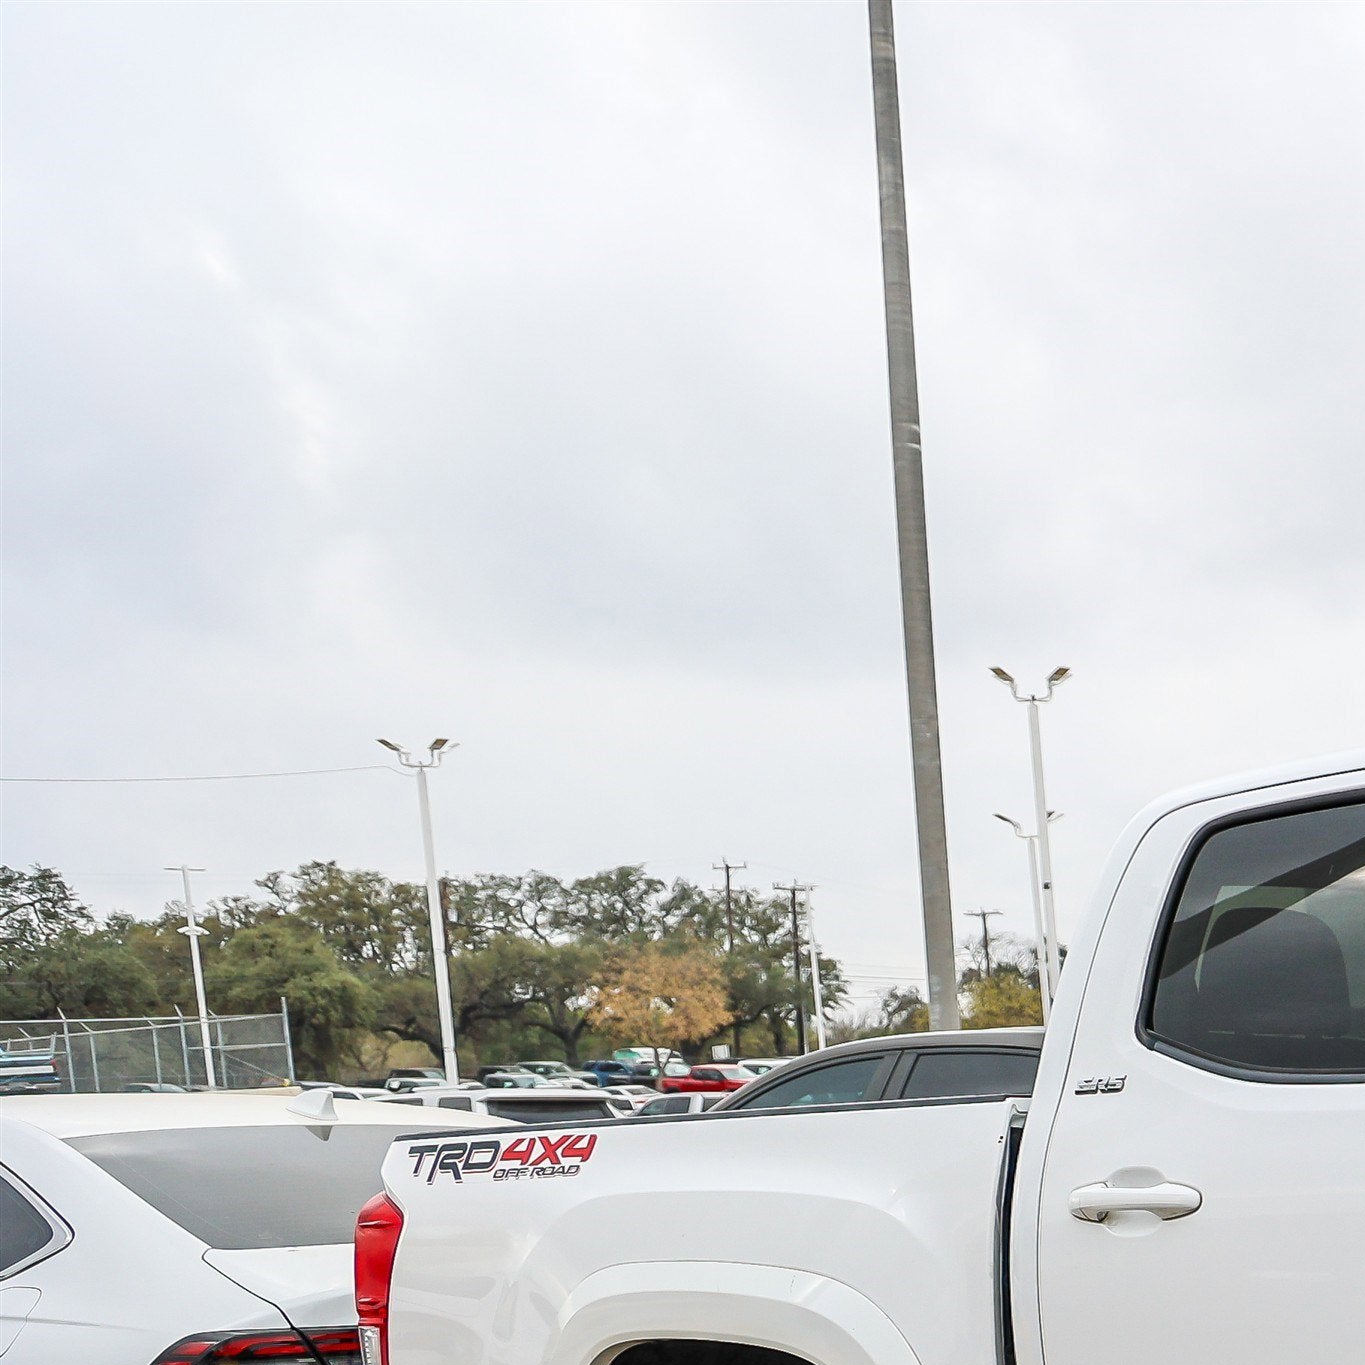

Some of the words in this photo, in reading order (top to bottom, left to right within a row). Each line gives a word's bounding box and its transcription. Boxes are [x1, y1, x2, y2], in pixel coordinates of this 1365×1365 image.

[1075, 1075, 1128, 1095] SR5
[408, 1140, 501, 1185] TRD
[500, 1134, 598, 1166] 4X4
[493, 1168, 530, 1181] OFF
[531, 1165, 581, 1178] ROAD
